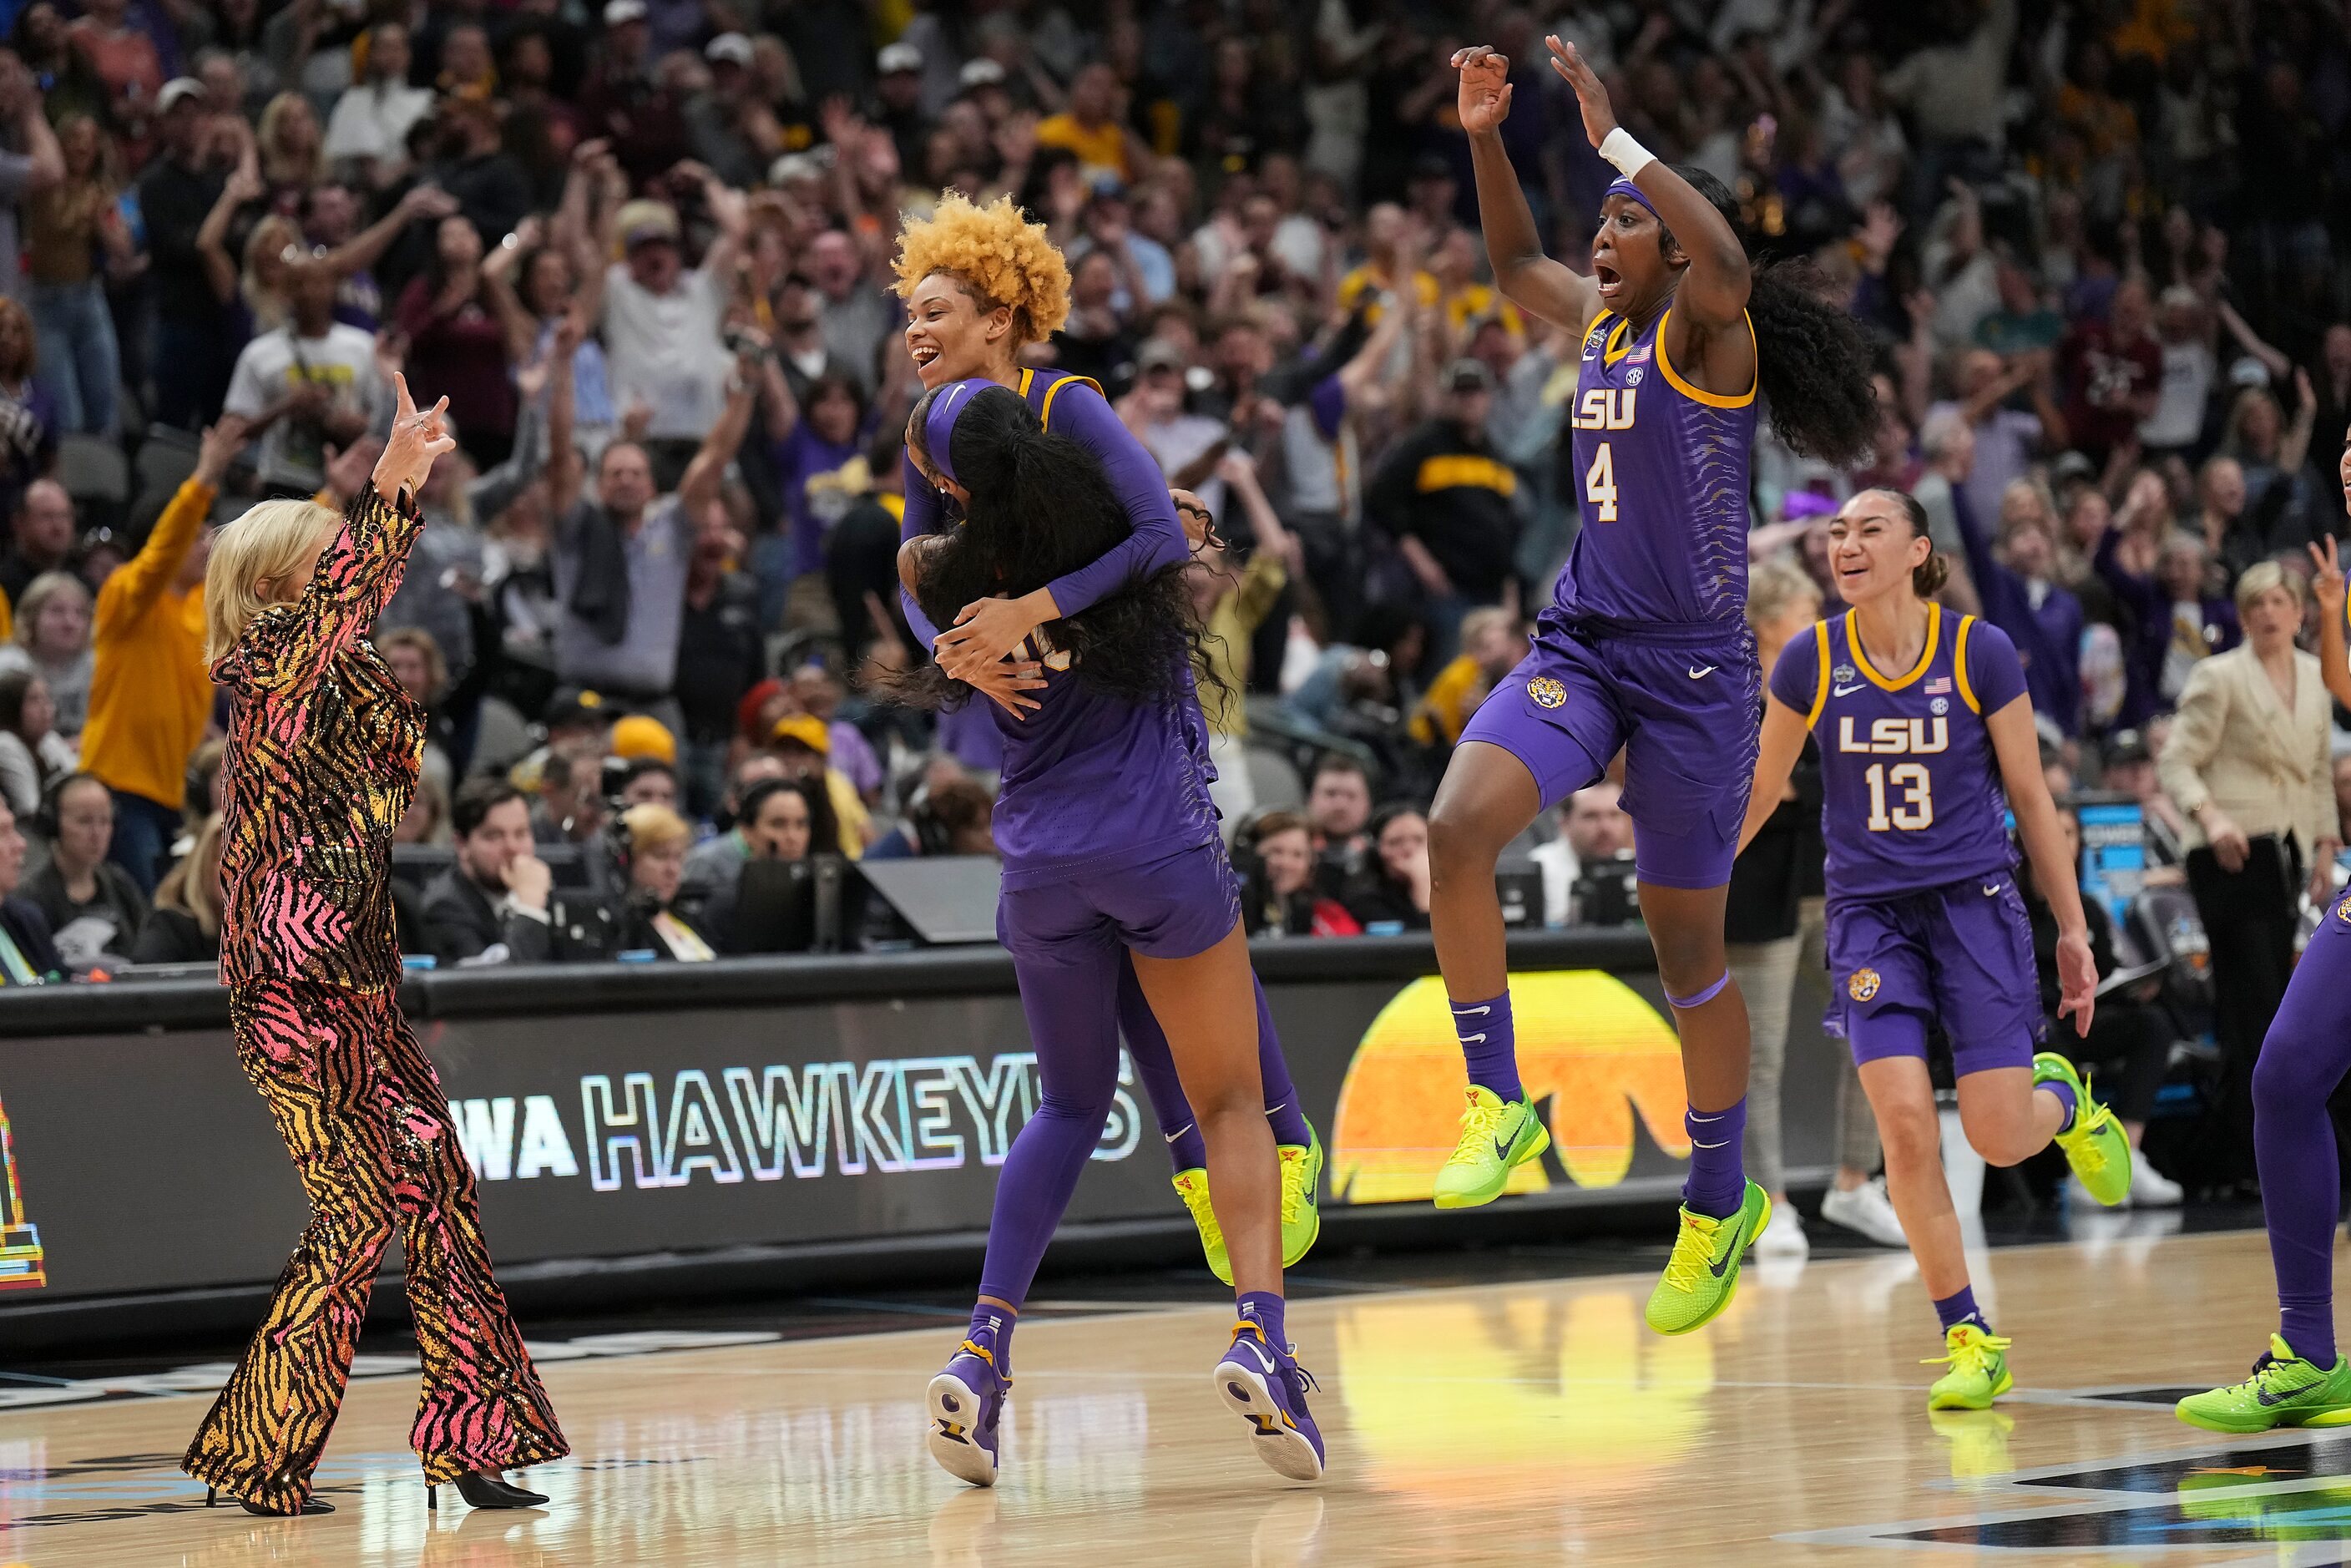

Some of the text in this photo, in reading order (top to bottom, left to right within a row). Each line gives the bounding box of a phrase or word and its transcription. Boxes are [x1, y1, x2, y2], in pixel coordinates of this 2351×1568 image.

[1627, 368, 1642, 384] SEC
[1571, 387, 1636, 430] LSU
[1586, 443, 1618, 522] 4
[1839, 716, 1949, 754] LSU
[1865, 762, 1934, 832] 13
[449, 1048, 1141, 1191] WA HAWKEYS
